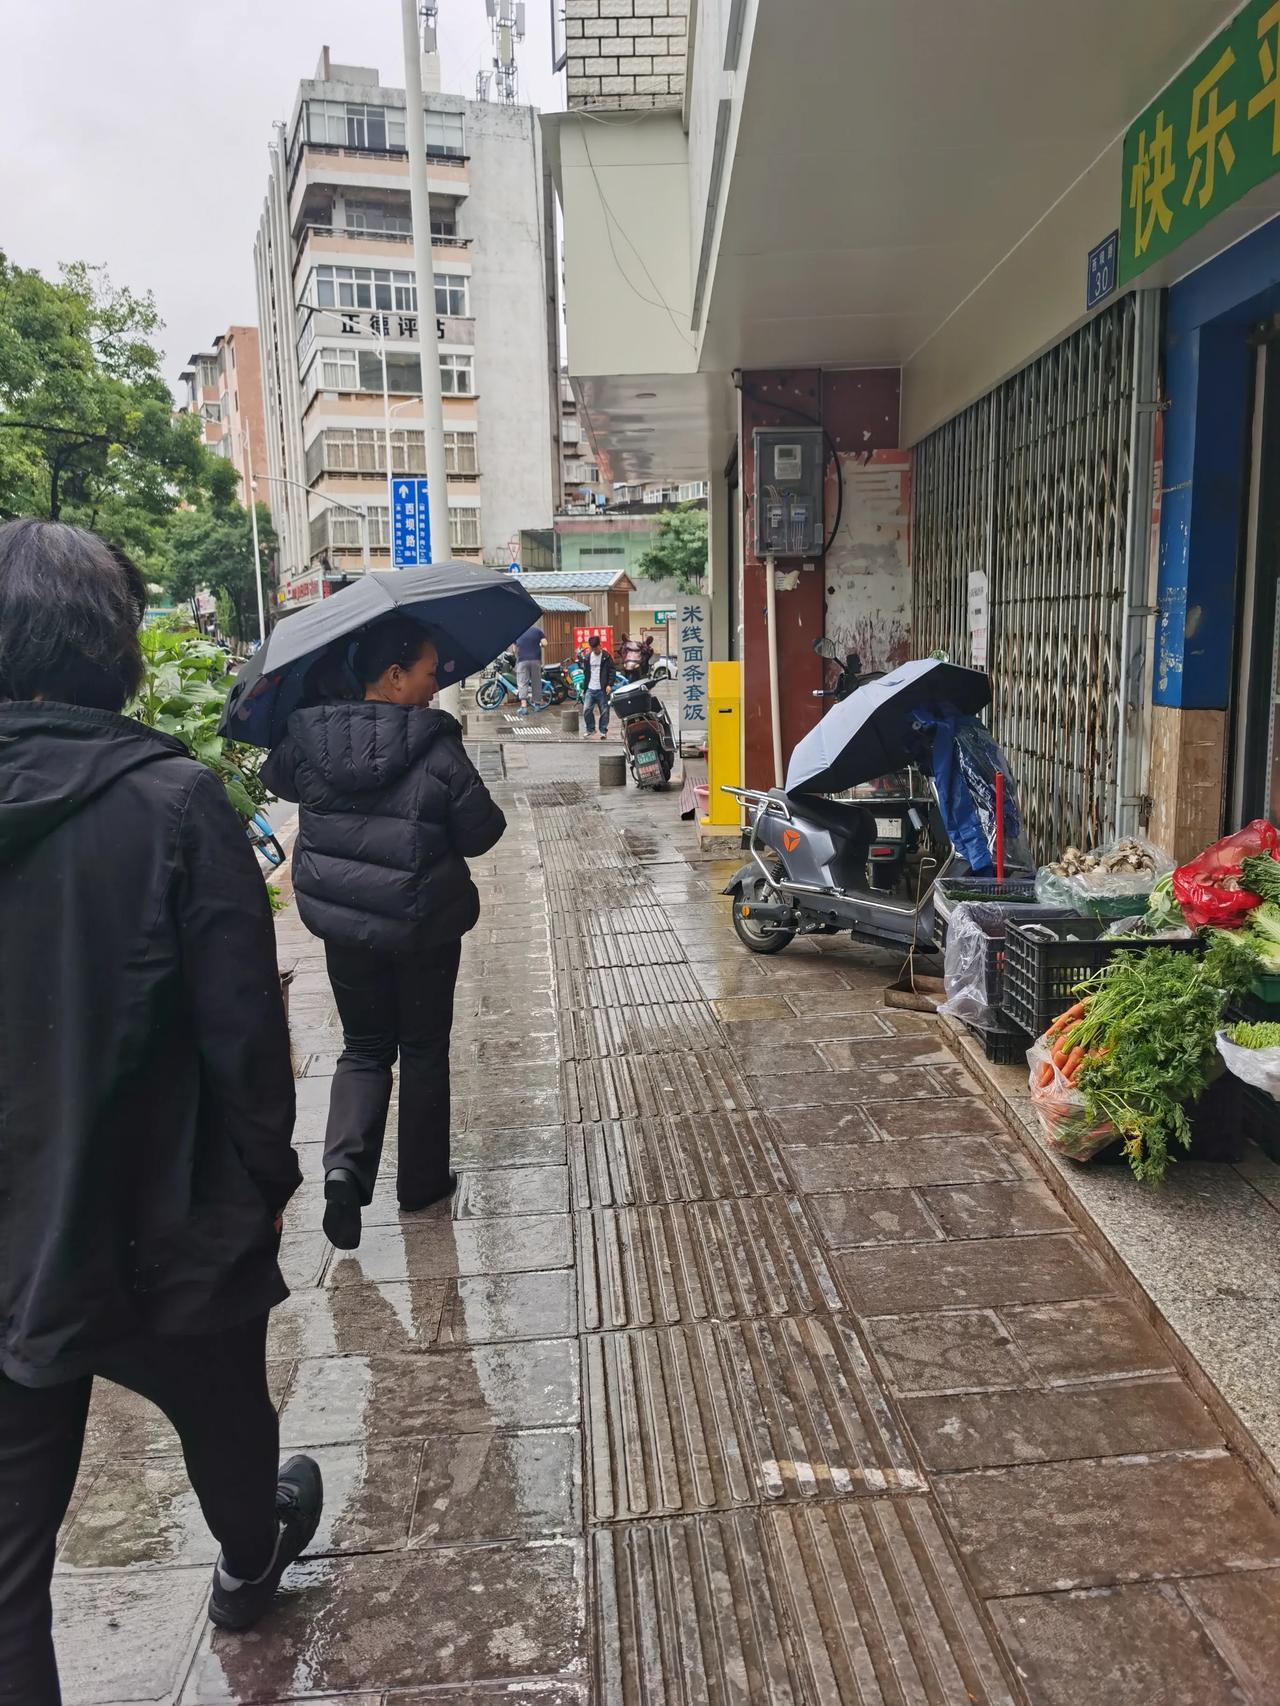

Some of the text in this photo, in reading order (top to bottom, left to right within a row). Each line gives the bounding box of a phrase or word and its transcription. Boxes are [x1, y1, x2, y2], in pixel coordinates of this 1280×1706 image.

[1094, 266, 1108, 297] 30
[681, 604, 706, 721] 米线面条套饭
